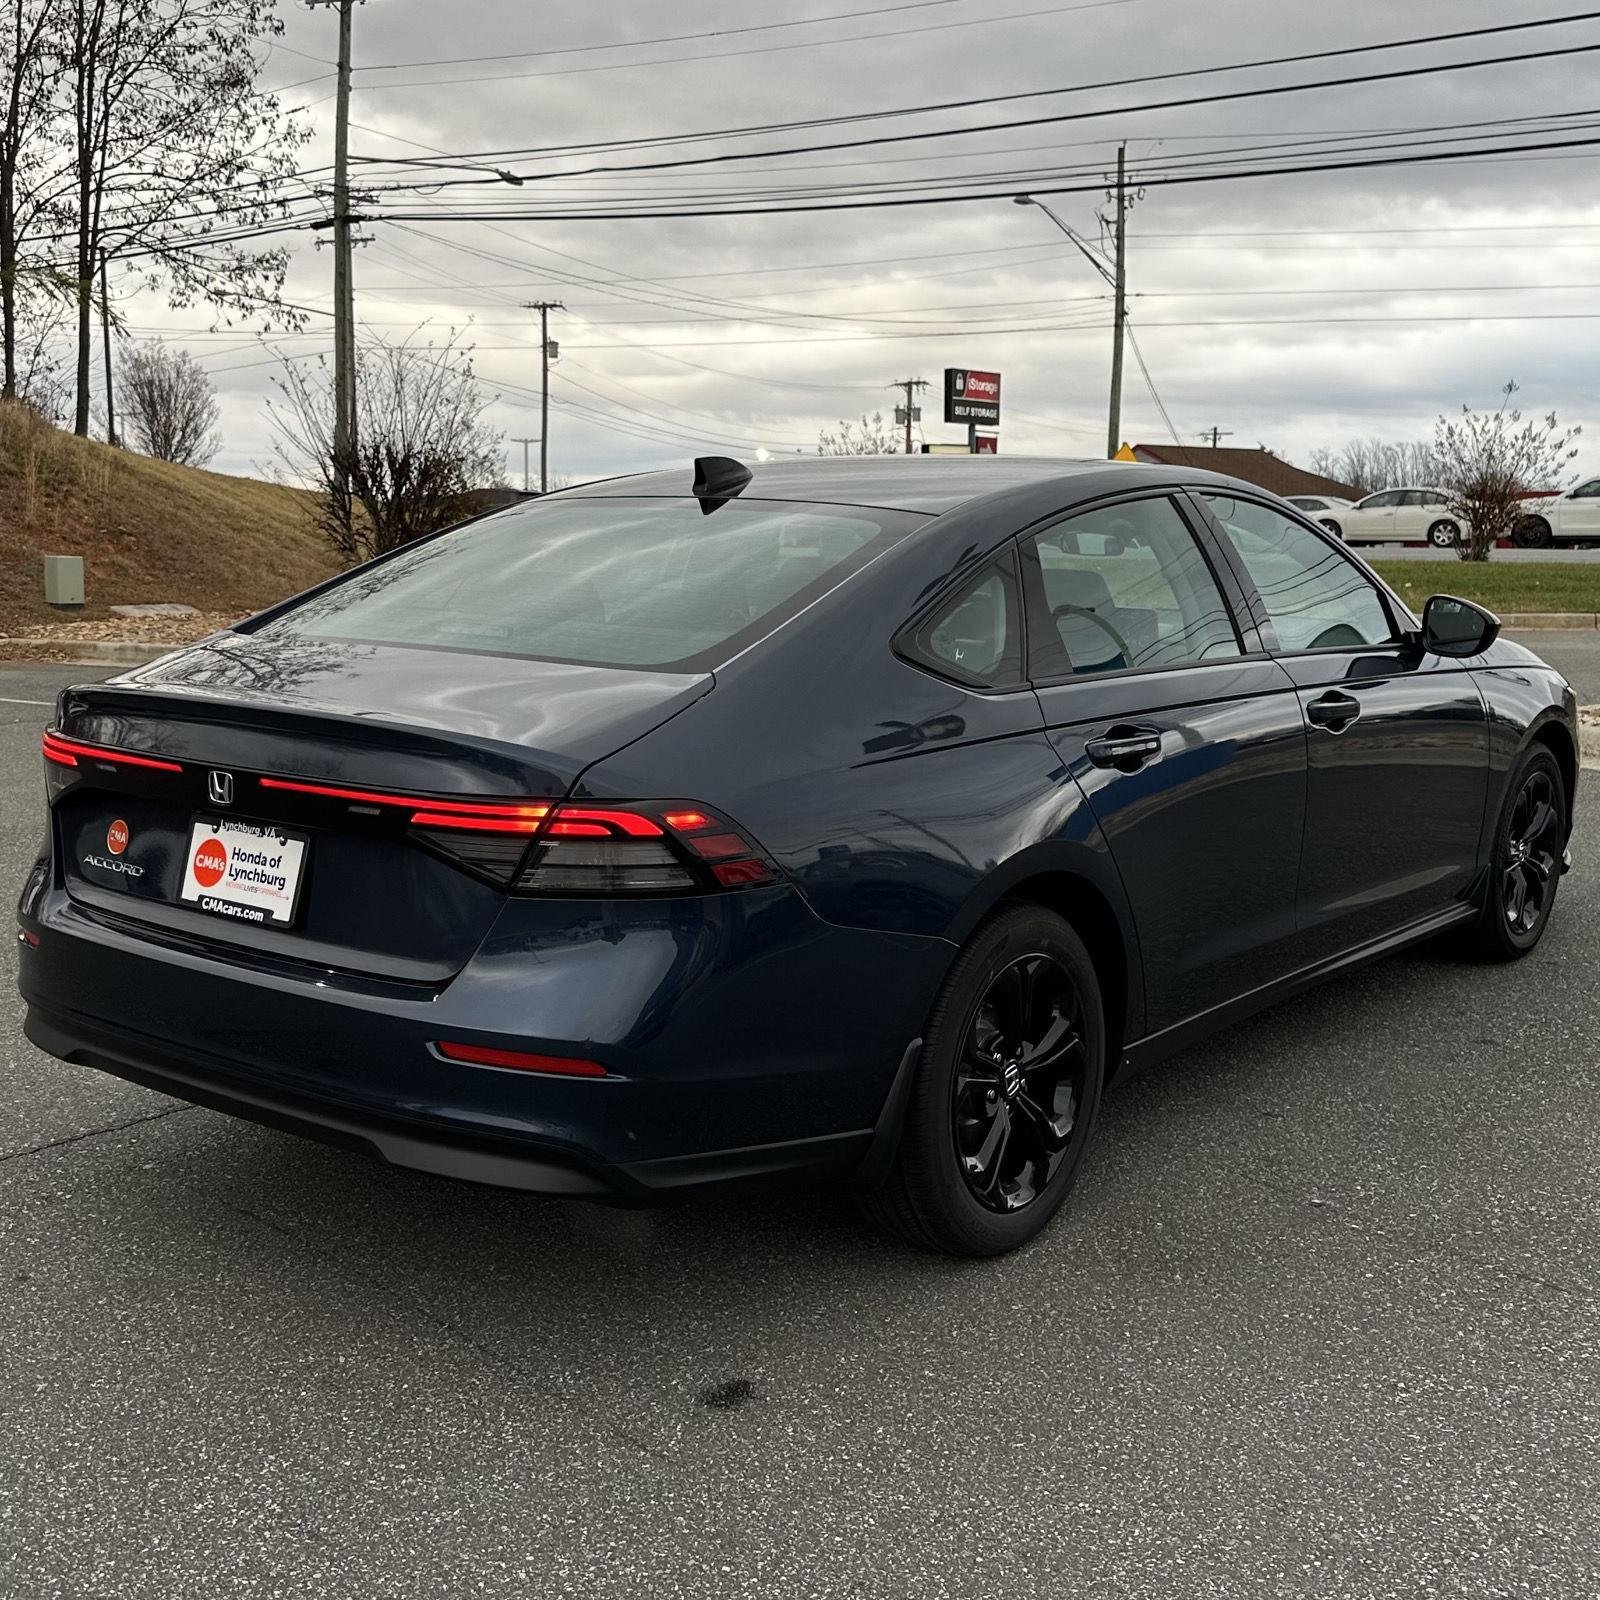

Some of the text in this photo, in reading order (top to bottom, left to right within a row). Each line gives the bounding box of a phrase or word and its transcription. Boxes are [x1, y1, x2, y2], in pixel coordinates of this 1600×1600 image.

[968, 378, 998, 395] iStorage
[954, 405, 997, 418] SELF STORAGE
[83, 854, 144, 877] ACCORD
[195, 854, 225, 871] CMA's
[232, 847, 282, 868] Honda of
[229, 864, 286, 890] Lynchburg
[201, 897, 264, 922] CMAcars.com
